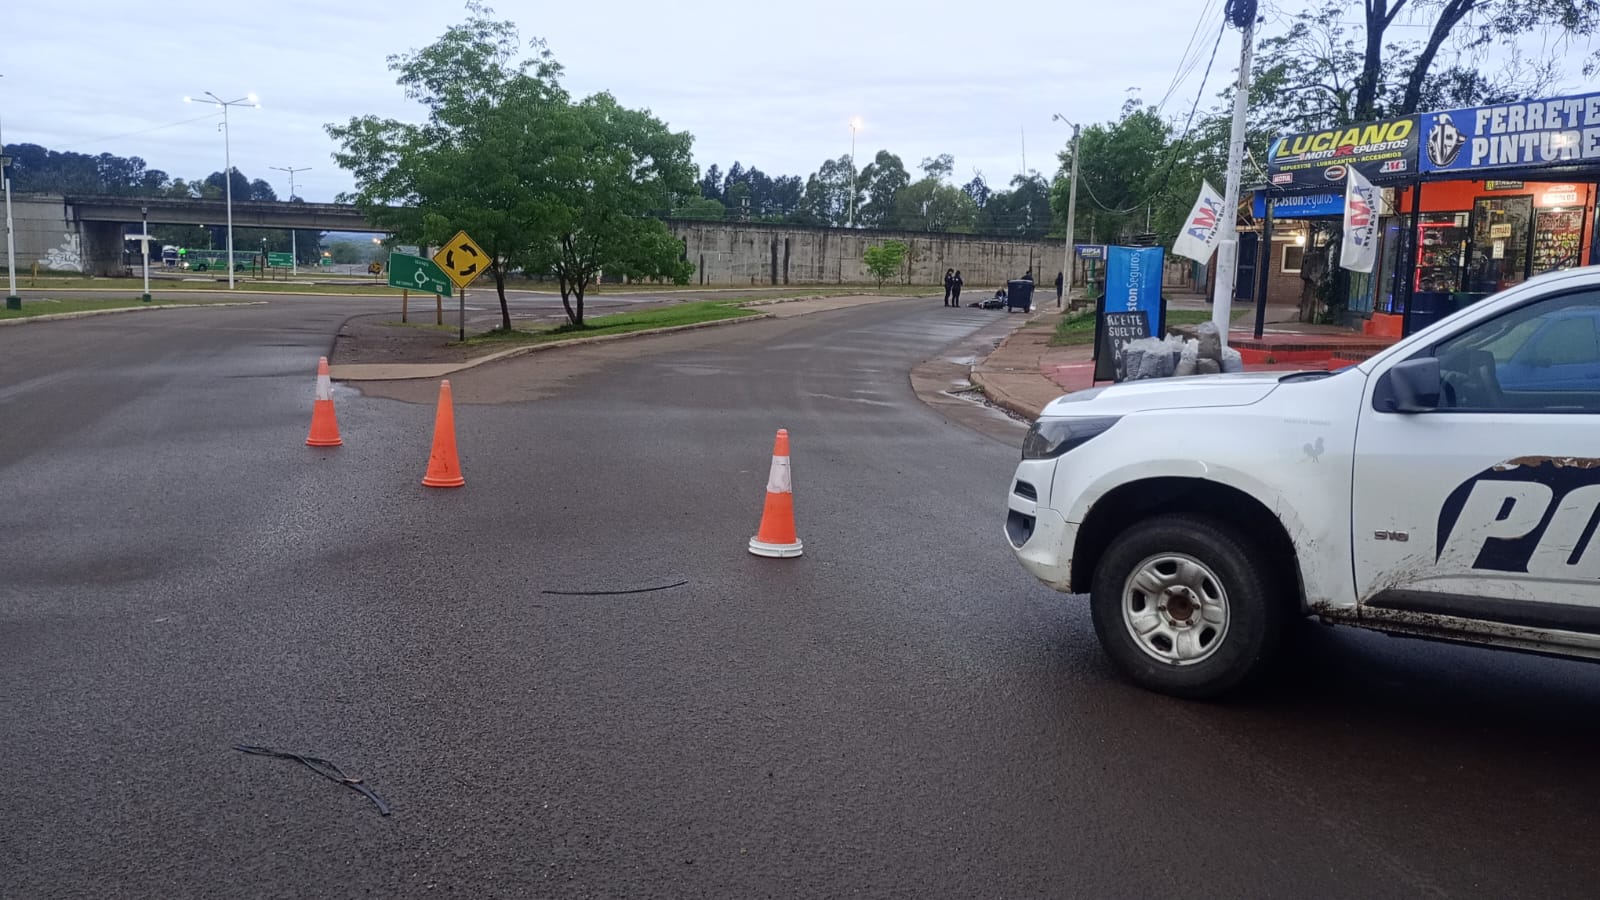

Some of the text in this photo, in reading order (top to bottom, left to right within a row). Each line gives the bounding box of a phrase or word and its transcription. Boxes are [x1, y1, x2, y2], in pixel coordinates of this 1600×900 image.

[1474, 96, 1600, 135] FERRETE
[1276, 119, 1413, 158] LUCIANO
[1471, 127, 1600, 166] PINTURE
[1280, 151, 1402, 171] REPUESTOS LUBRICANTES ACCESORIOS
[1107, 314, 1143, 326] ACEITE
[1109, 326, 1143, 337] SUELTO
[1374, 529, 1409, 542] S10
